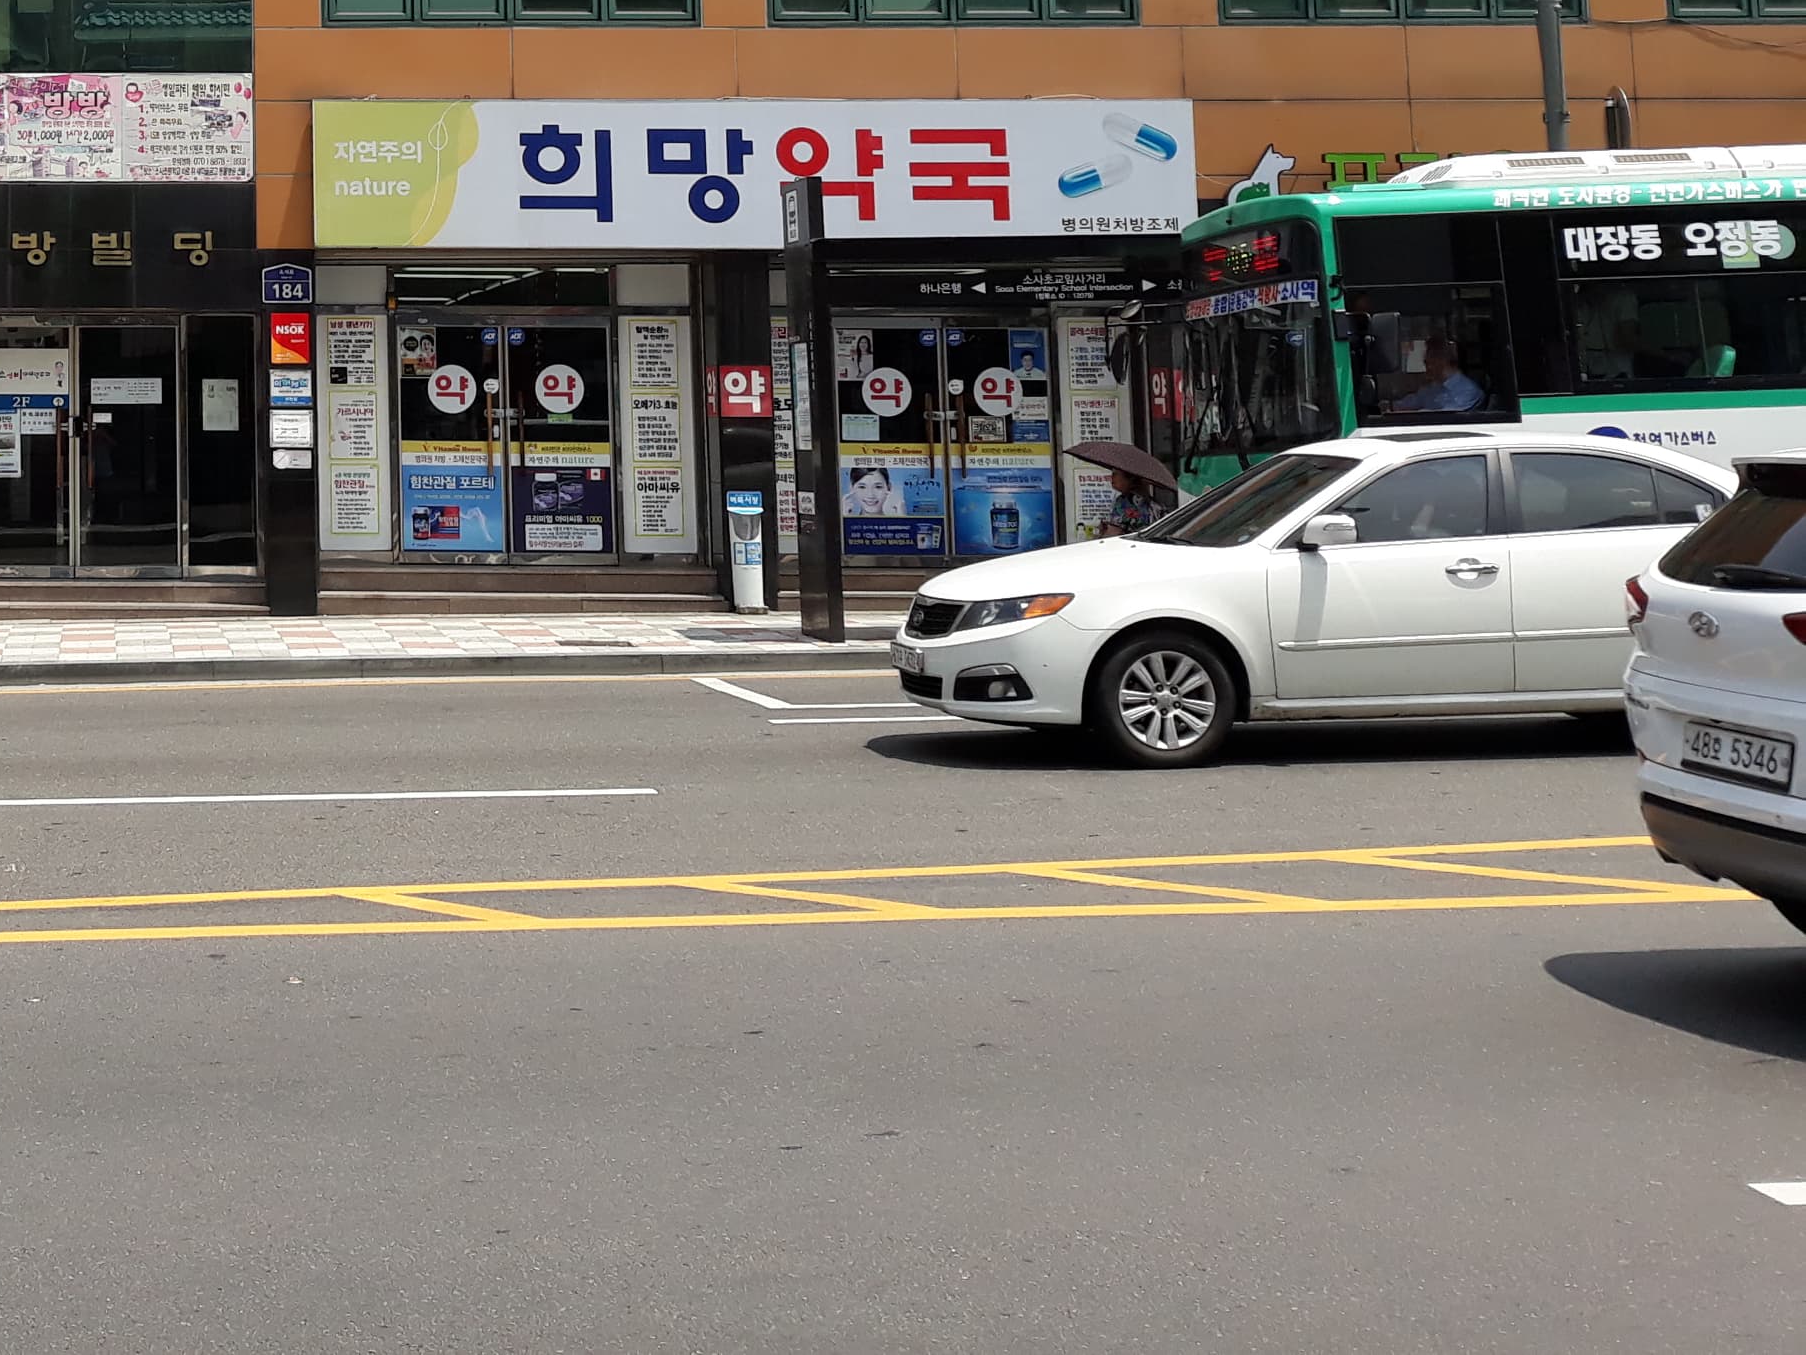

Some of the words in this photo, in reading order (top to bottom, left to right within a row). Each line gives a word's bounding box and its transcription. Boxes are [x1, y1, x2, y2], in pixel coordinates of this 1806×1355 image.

[43, 90, 109, 120] 방방
[333, 139, 423, 164] 자연주의
[334, 177, 411, 196] nature
[1061, 217, 1180, 232] 병의원처방조제
[1562, 224, 1662, 262] 대장동
[1684, 220, 1783, 258] 오정동
[272, 283, 303, 299] 184
[919, 282, 962, 294] 하나은행
[995, 285, 1015, 293] Sosa
[1017, 285, 1059, 294] Elementary
[1061, 284, 1087, 292] School
[1090, 284, 1134, 292] Intersection
[276, 325, 305, 335] NSOK
[435, 375, 470, 405] 약
[543, 375, 576, 405] 약
[724, 370, 767, 414] 약
[870, 378, 904, 408] 약
[981, 378, 1016, 408] 약
[12, 396, 31, 408] 2F
[410, 475, 456, 489] 힘찬관절
[458, 476, 494, 490] 포르테
[637, 482, 680, 493] 아마씨유
[586, 515, 603, 523] 1000
[1730, 737, 1778, 774] 5346
